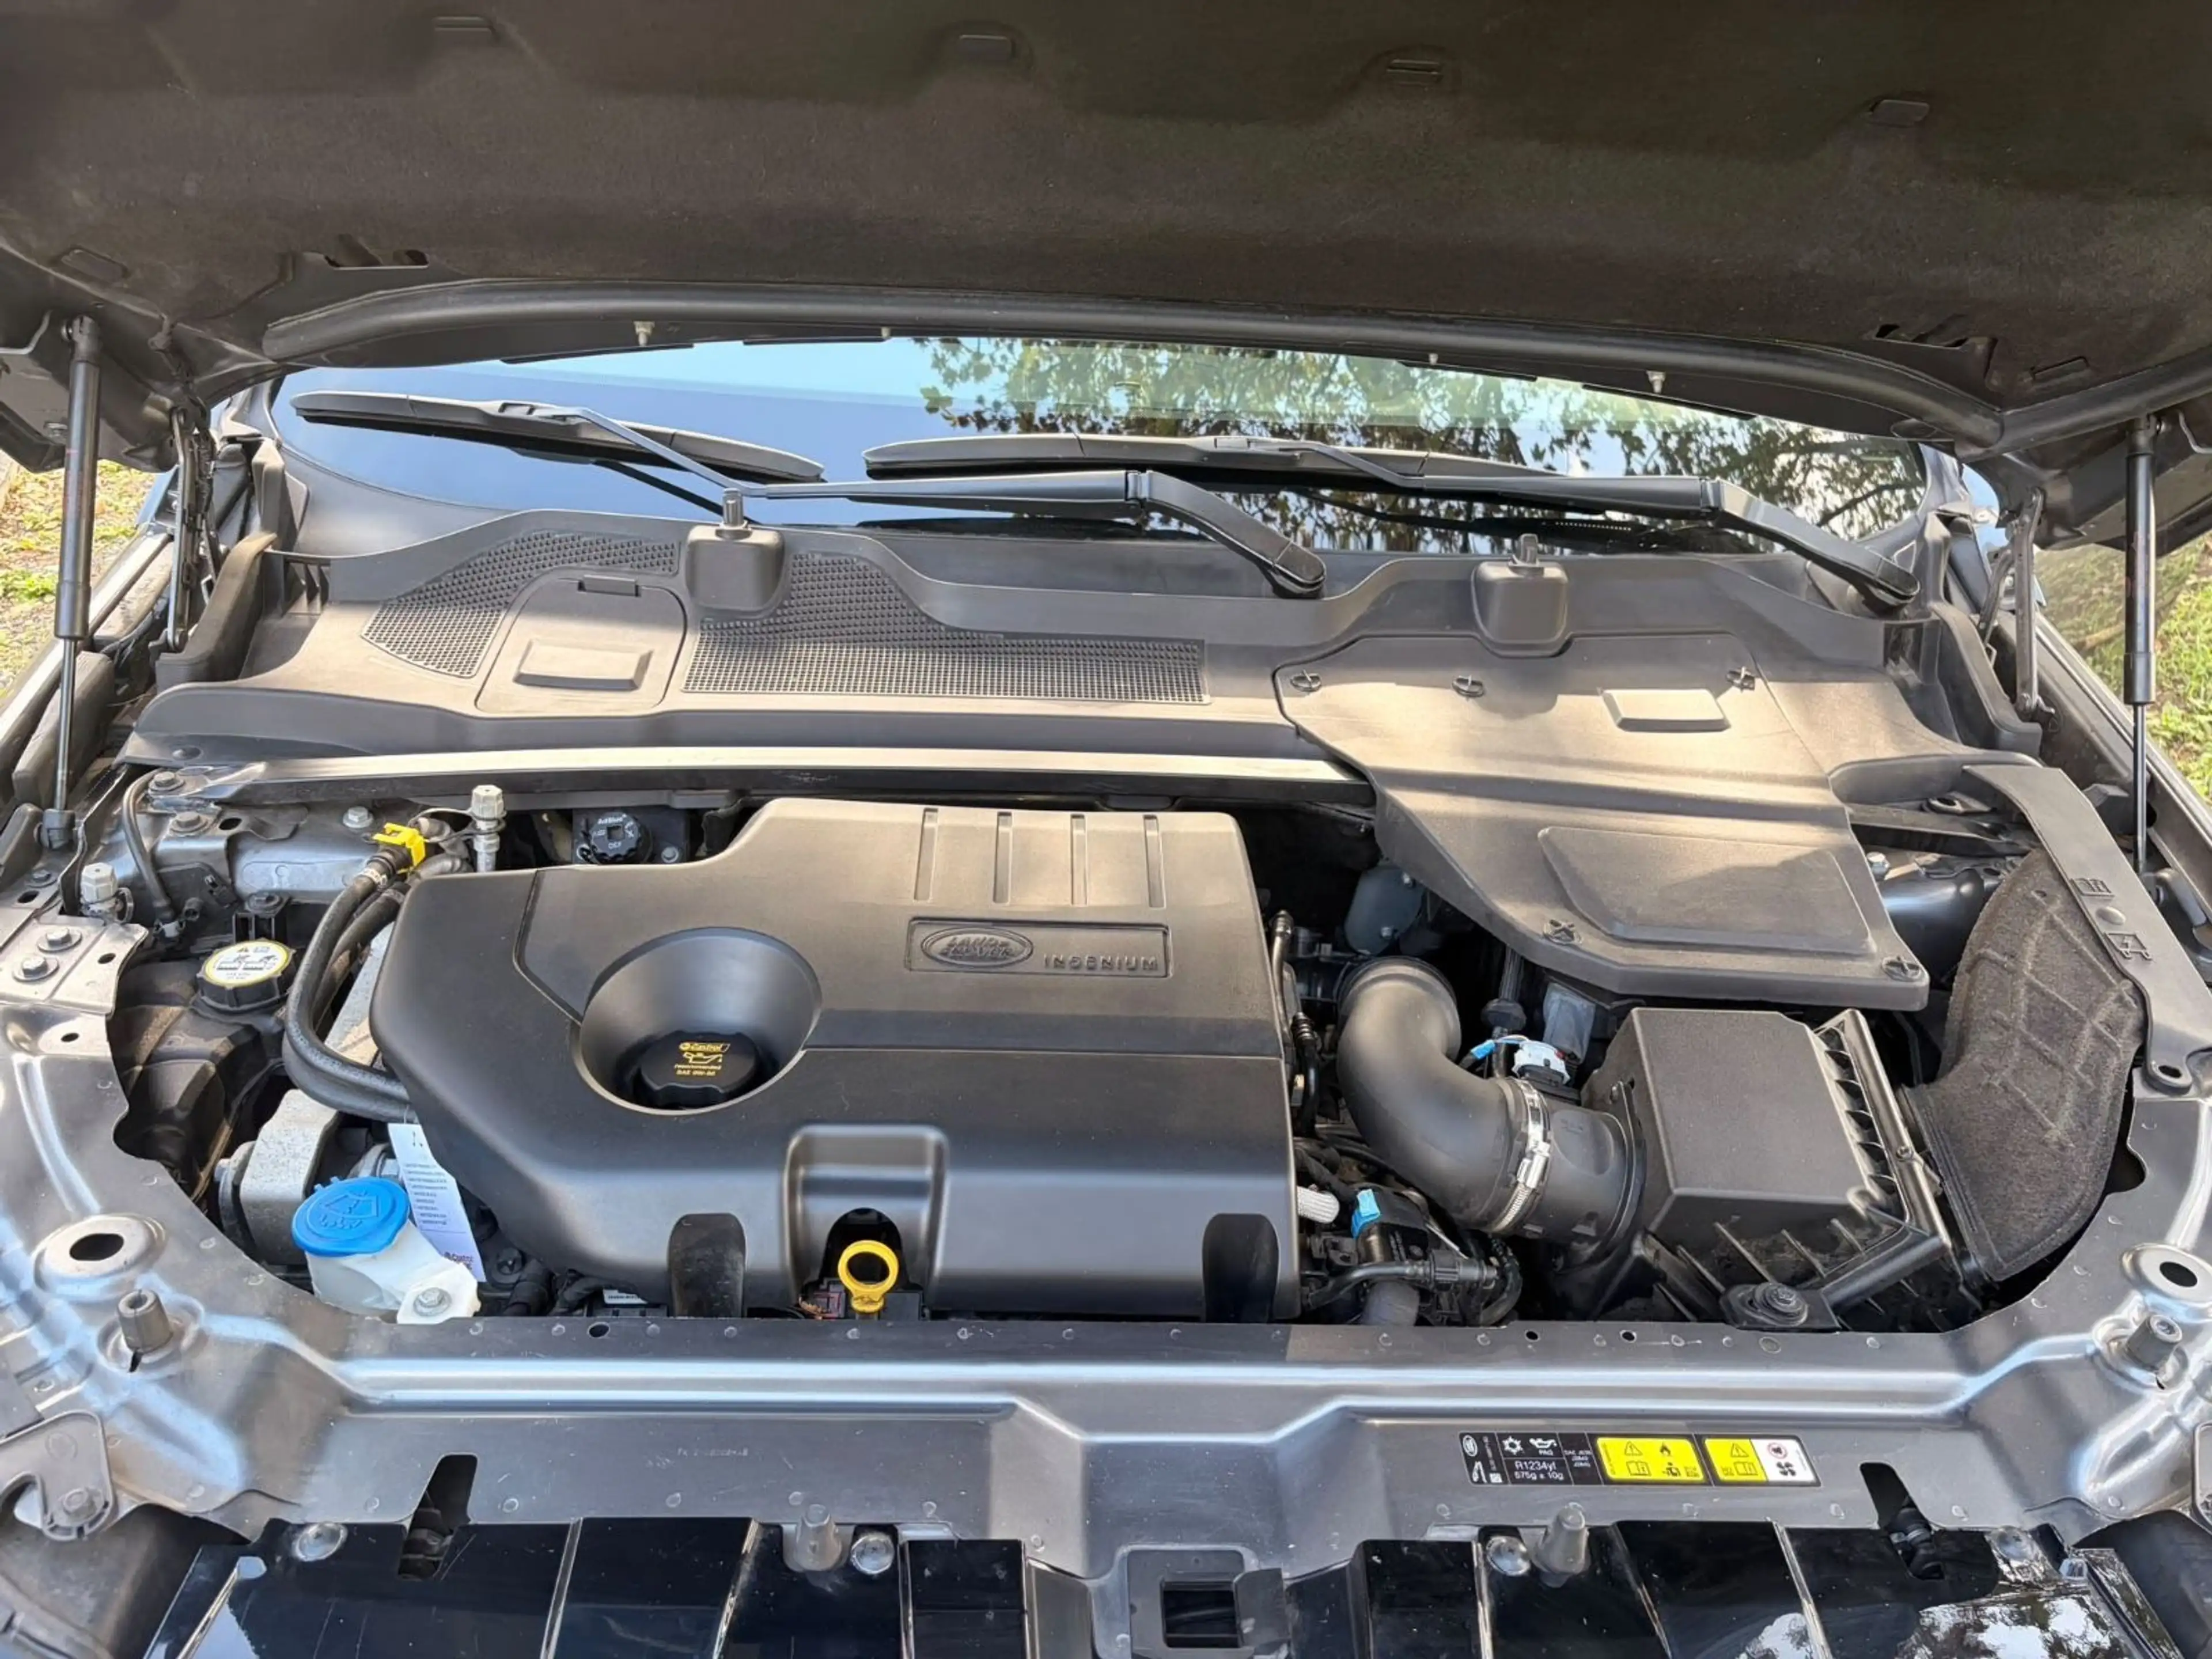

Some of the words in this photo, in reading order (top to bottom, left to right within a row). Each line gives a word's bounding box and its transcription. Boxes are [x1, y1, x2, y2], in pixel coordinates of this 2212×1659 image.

[1043, 954, 1158, 971] INGENIUM
[690, 1043, 721, 1052] Castrol
[1514, 1461, 1556, 1472] R1234yf
[1547, 1471, 1565, 1480] 10g
